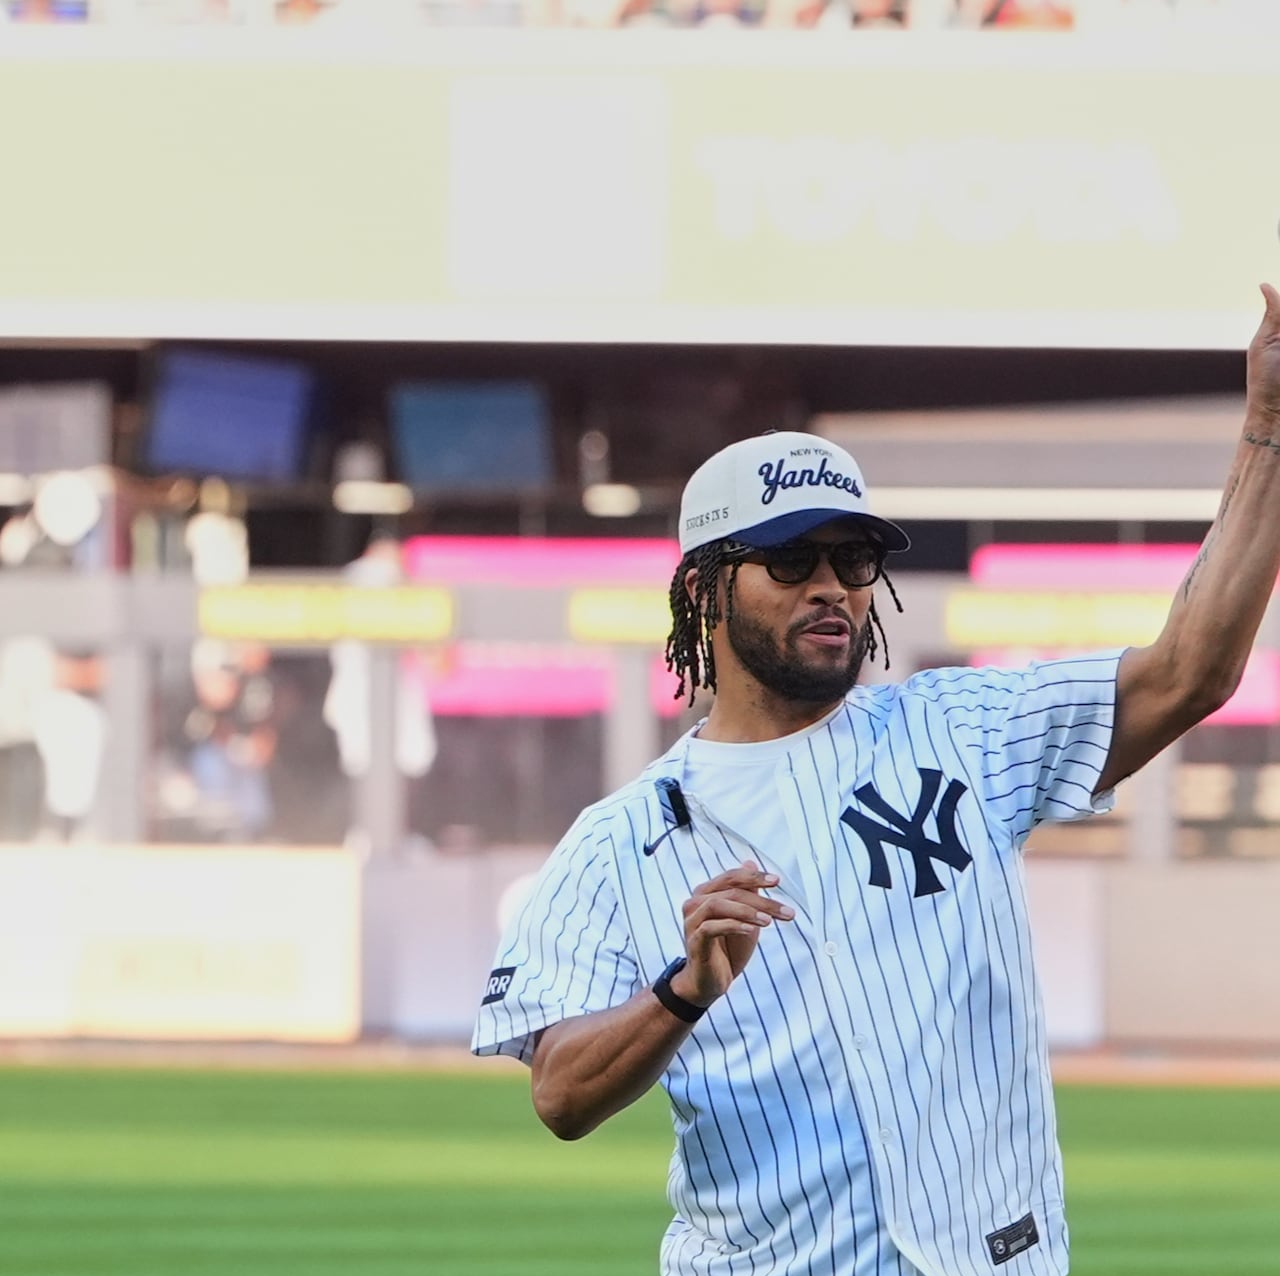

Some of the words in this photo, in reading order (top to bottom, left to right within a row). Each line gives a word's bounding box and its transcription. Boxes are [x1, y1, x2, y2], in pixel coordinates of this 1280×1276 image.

[790, 448, 811, 457] NEW
[758, 457, 862, 505] Yankees
[840, 767, 973, 898] NY
